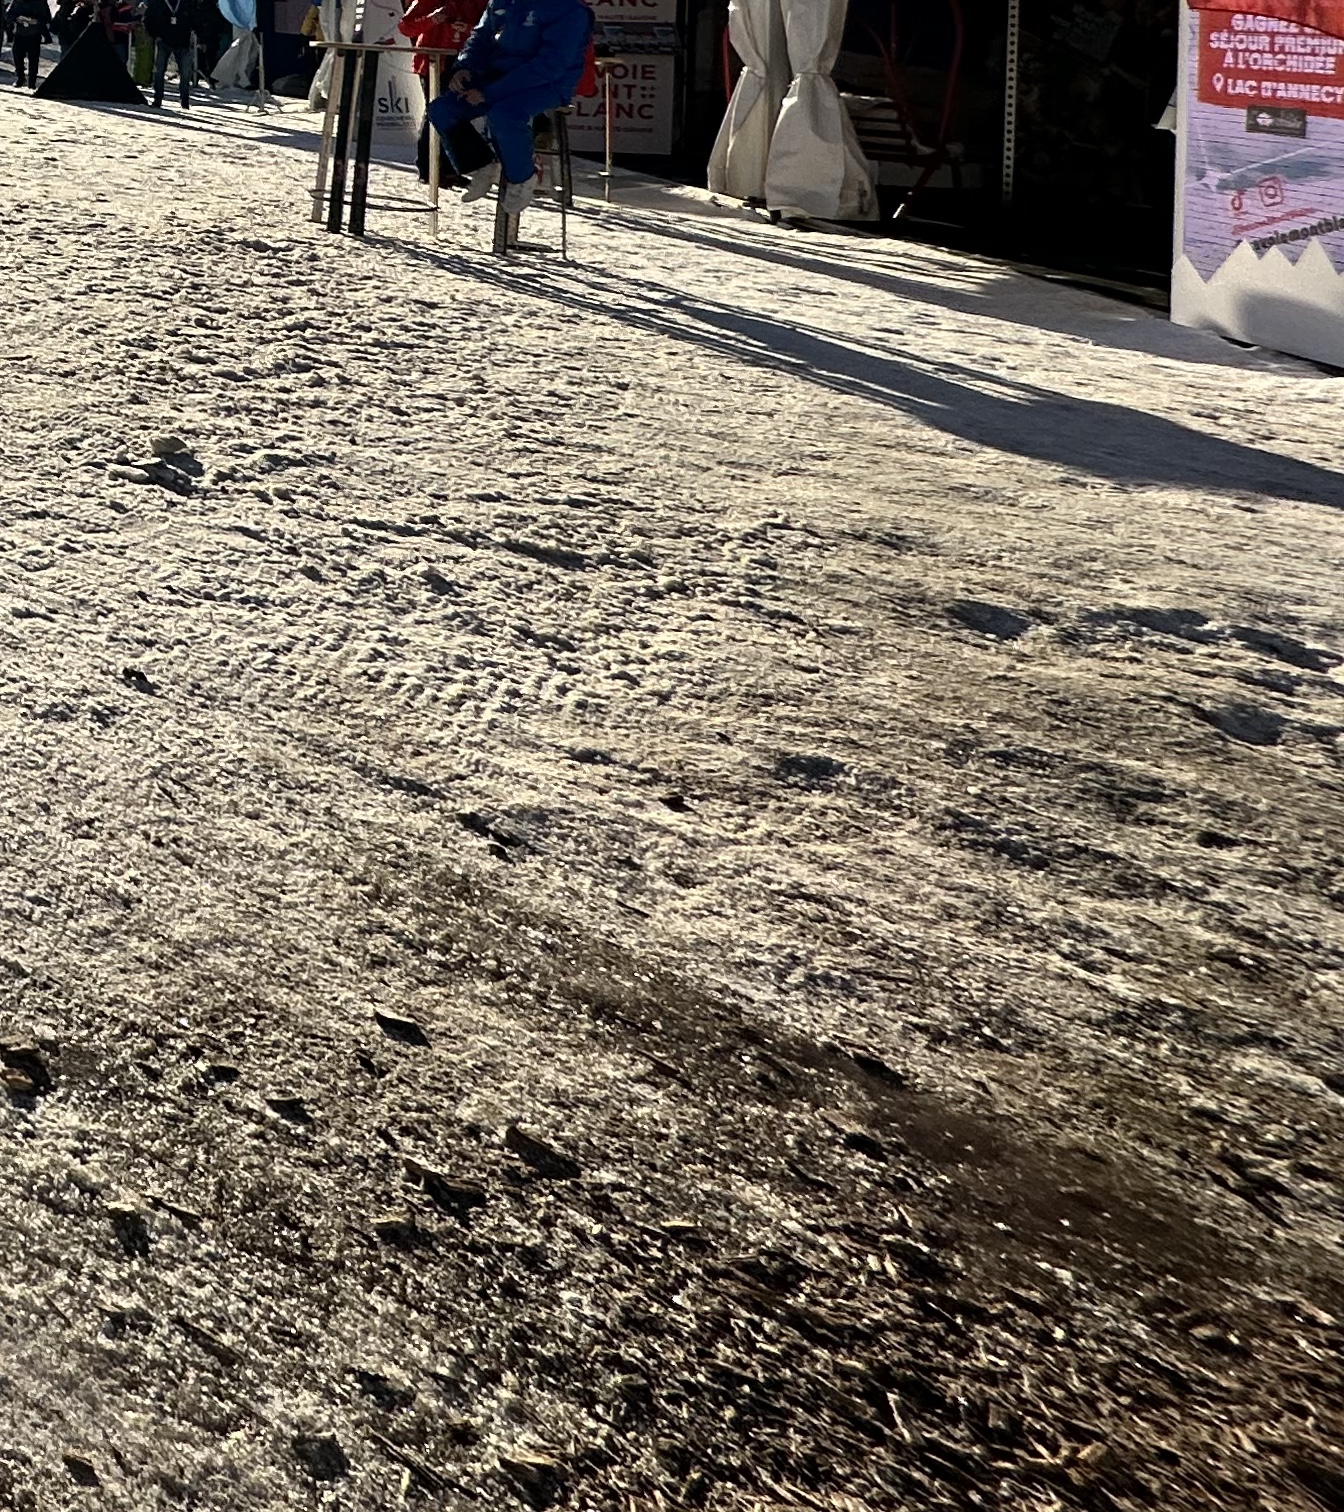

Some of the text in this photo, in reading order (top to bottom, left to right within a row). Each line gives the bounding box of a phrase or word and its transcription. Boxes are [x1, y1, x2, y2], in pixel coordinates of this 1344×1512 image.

[1209, 29, 1270, 52] SÉJOUR
[594, 63, 657, 81] VOIE
[1226, 78, 1258, 97] LAC
[562, 103, 655, 120] LANC
